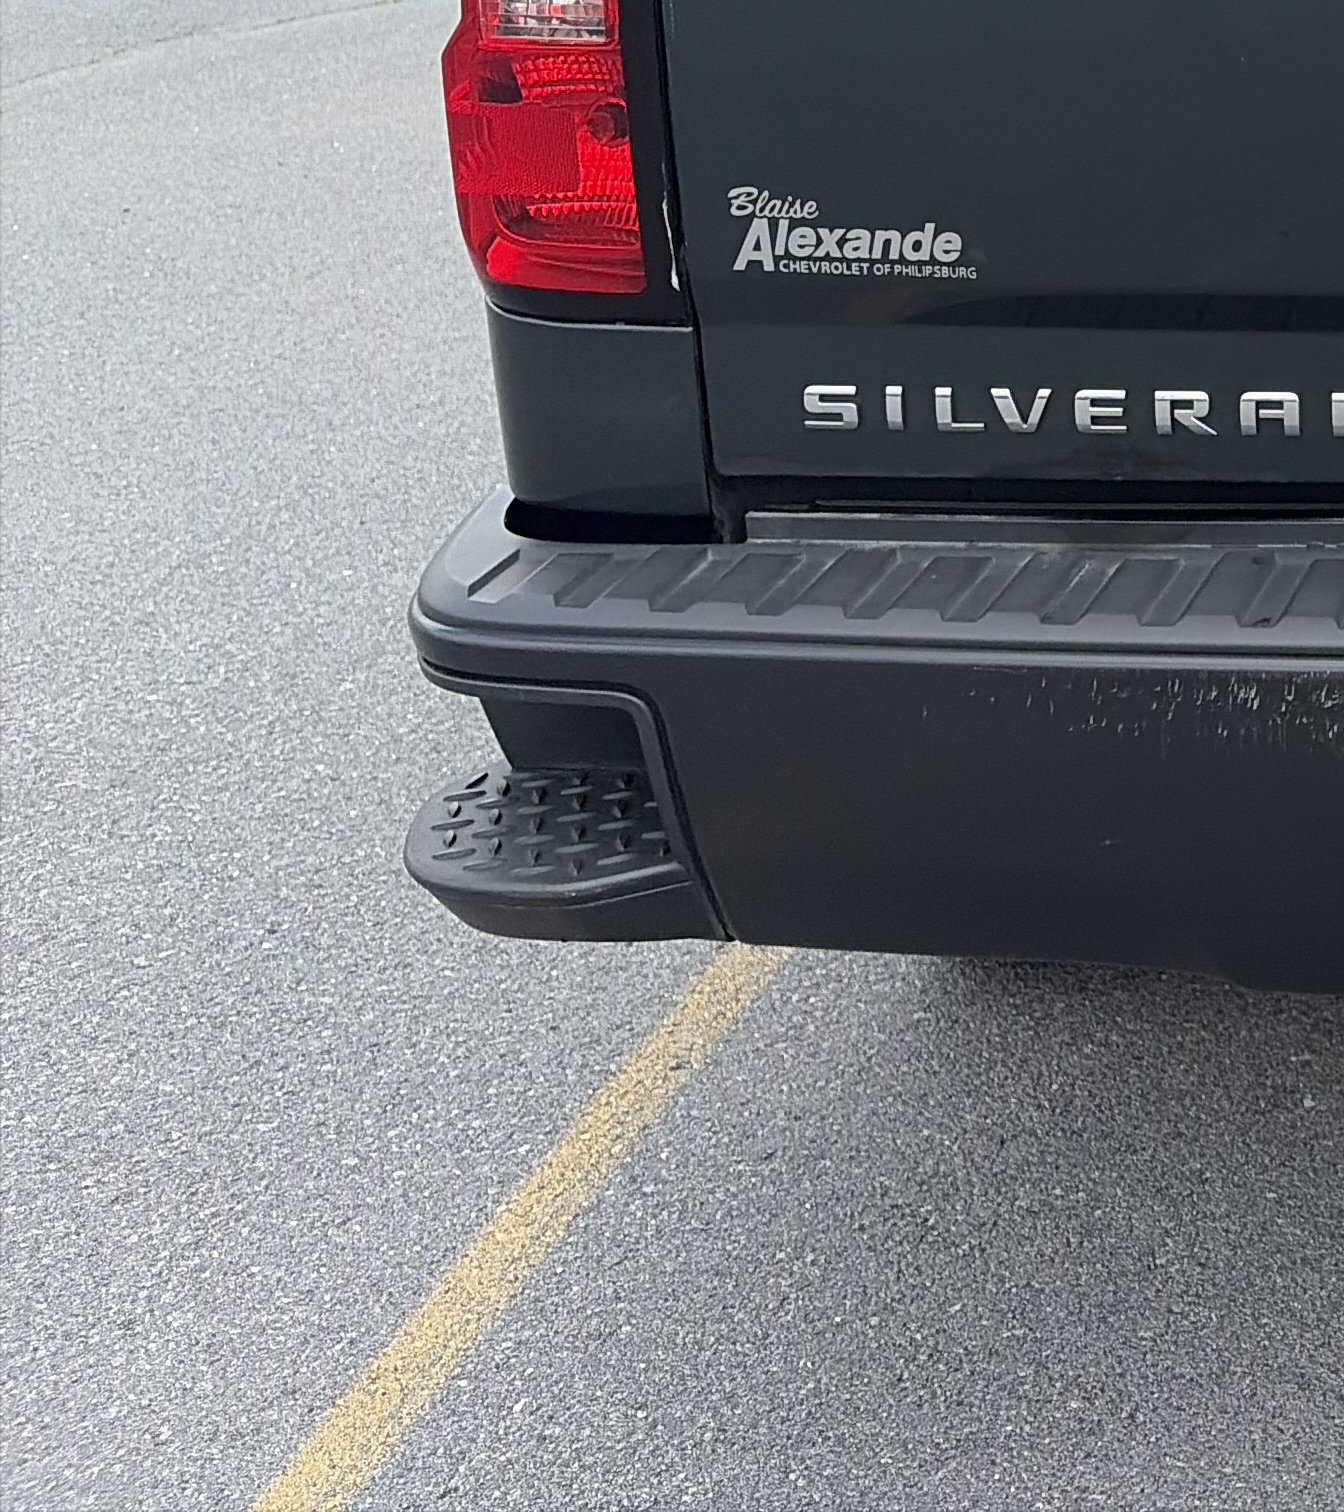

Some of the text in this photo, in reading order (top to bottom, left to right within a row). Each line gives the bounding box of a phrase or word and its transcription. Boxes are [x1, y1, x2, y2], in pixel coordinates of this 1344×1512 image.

[727, 186, 819, 219] Blaise
[732, 217, 963, 272] Alexande
[779, 259, 977, 279] CHEVROLET OF PHILIPSBURG
